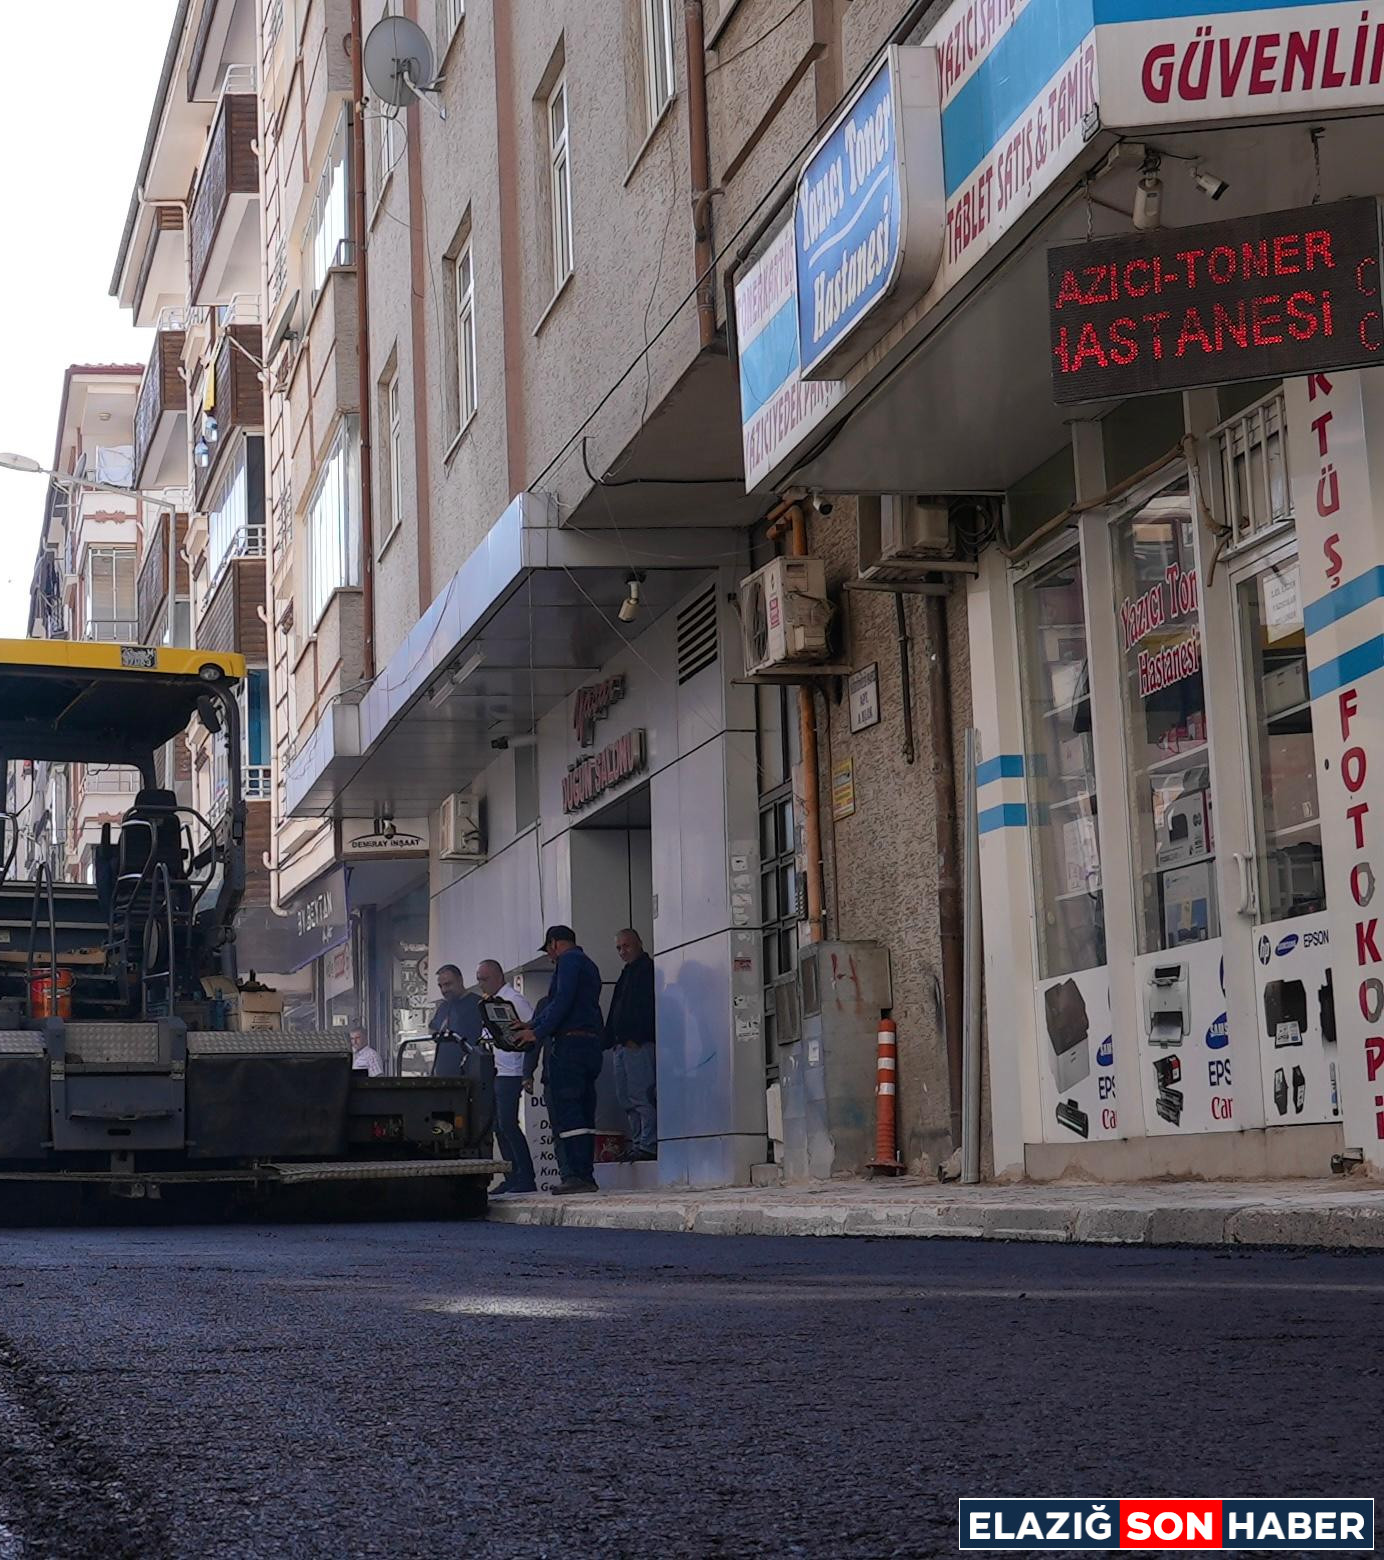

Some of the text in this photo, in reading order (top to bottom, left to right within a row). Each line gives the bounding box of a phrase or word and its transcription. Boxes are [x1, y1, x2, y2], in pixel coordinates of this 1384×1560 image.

[844, 92, 891, 197] Toner
[947, 38, 1097, 265] TABLET SATIŞ & TAMİR
[813, 194, 890, 344] Hastanesi
[1051, 230, 1336, 310] AZICI-TONER
[1138, 625, 1199, 698] Hastanesi
[1303, 929, 1329, 948] EPSON
[1208, 1058, 1232, 1087] EPS
